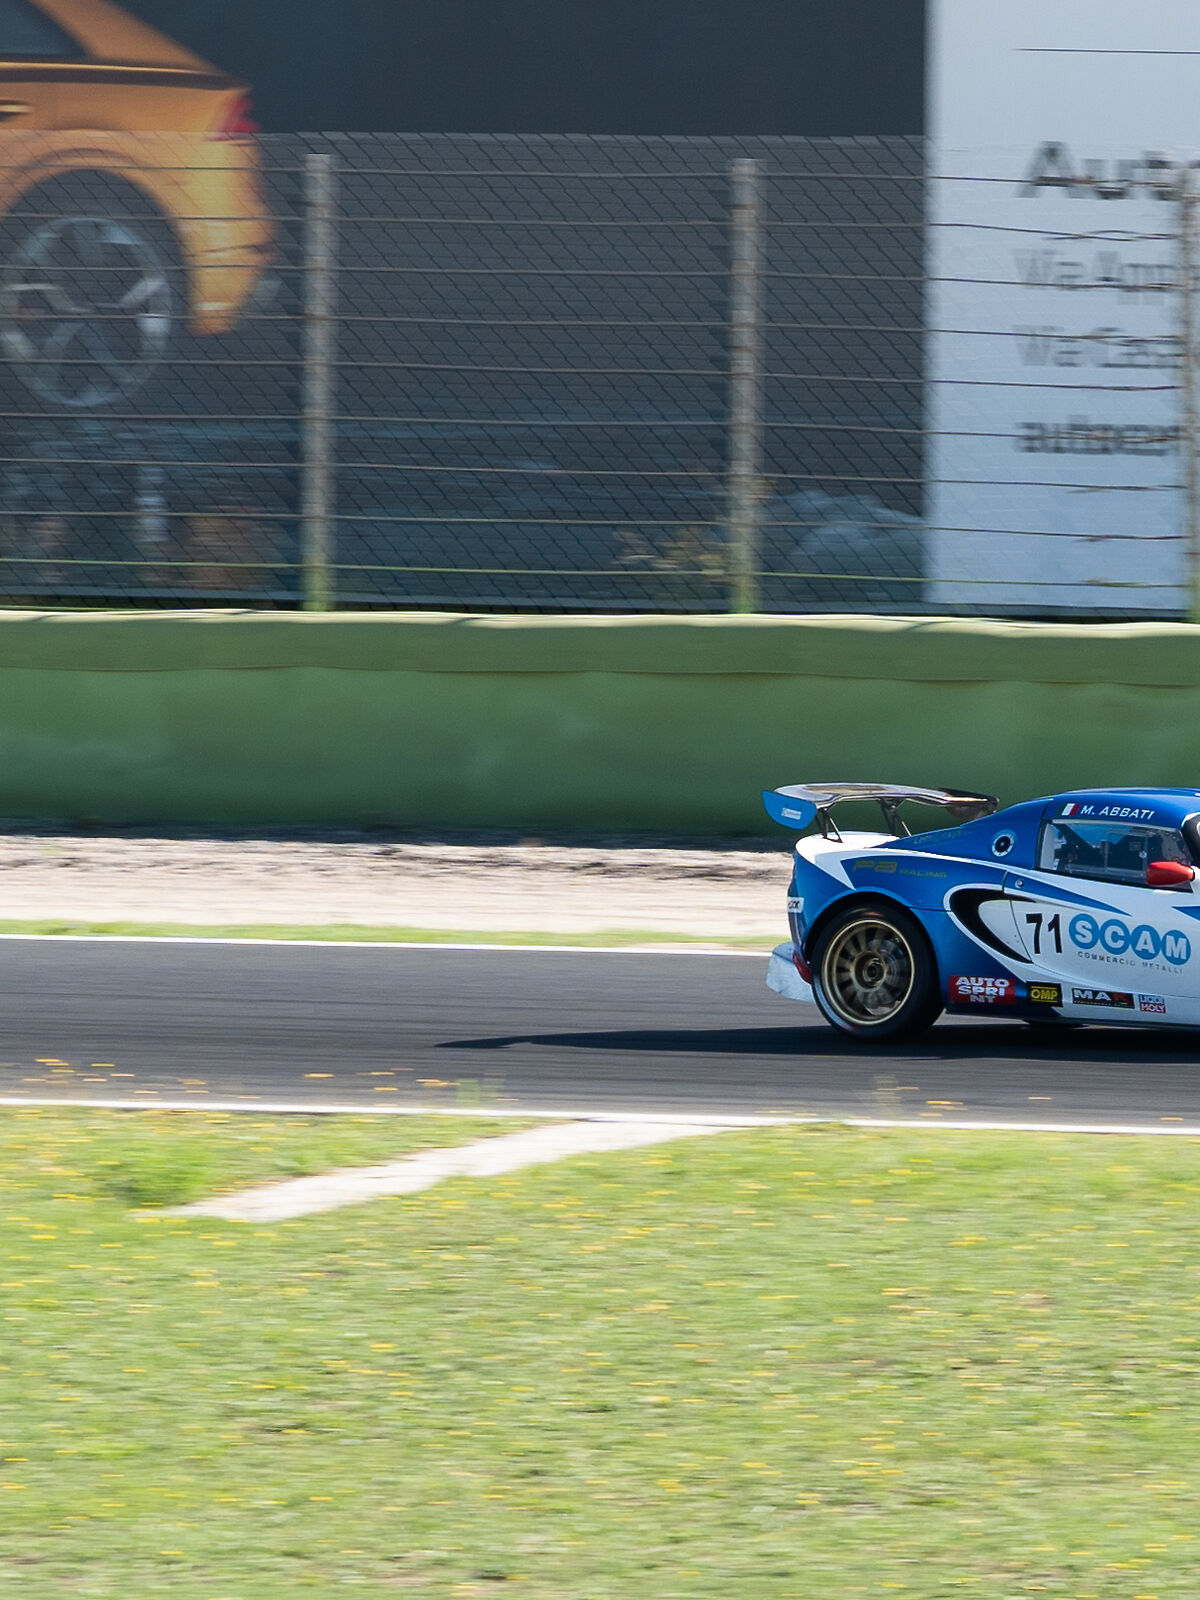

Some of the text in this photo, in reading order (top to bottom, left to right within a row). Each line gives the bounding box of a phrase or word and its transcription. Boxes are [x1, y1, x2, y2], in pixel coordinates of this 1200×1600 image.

[1080, 805, 1155, 820] M. ABBATI
[1025, 913, 1063, 955] 71
[1073, 917, 1189, 961] SCAM
[1077, 951, 1136, 967] COMMERCIO
[956, 976, 1010, 987] AUTO
[957, 985, 1006, 996] SPRI
[1030, 988, 1058, 1000] OMP
